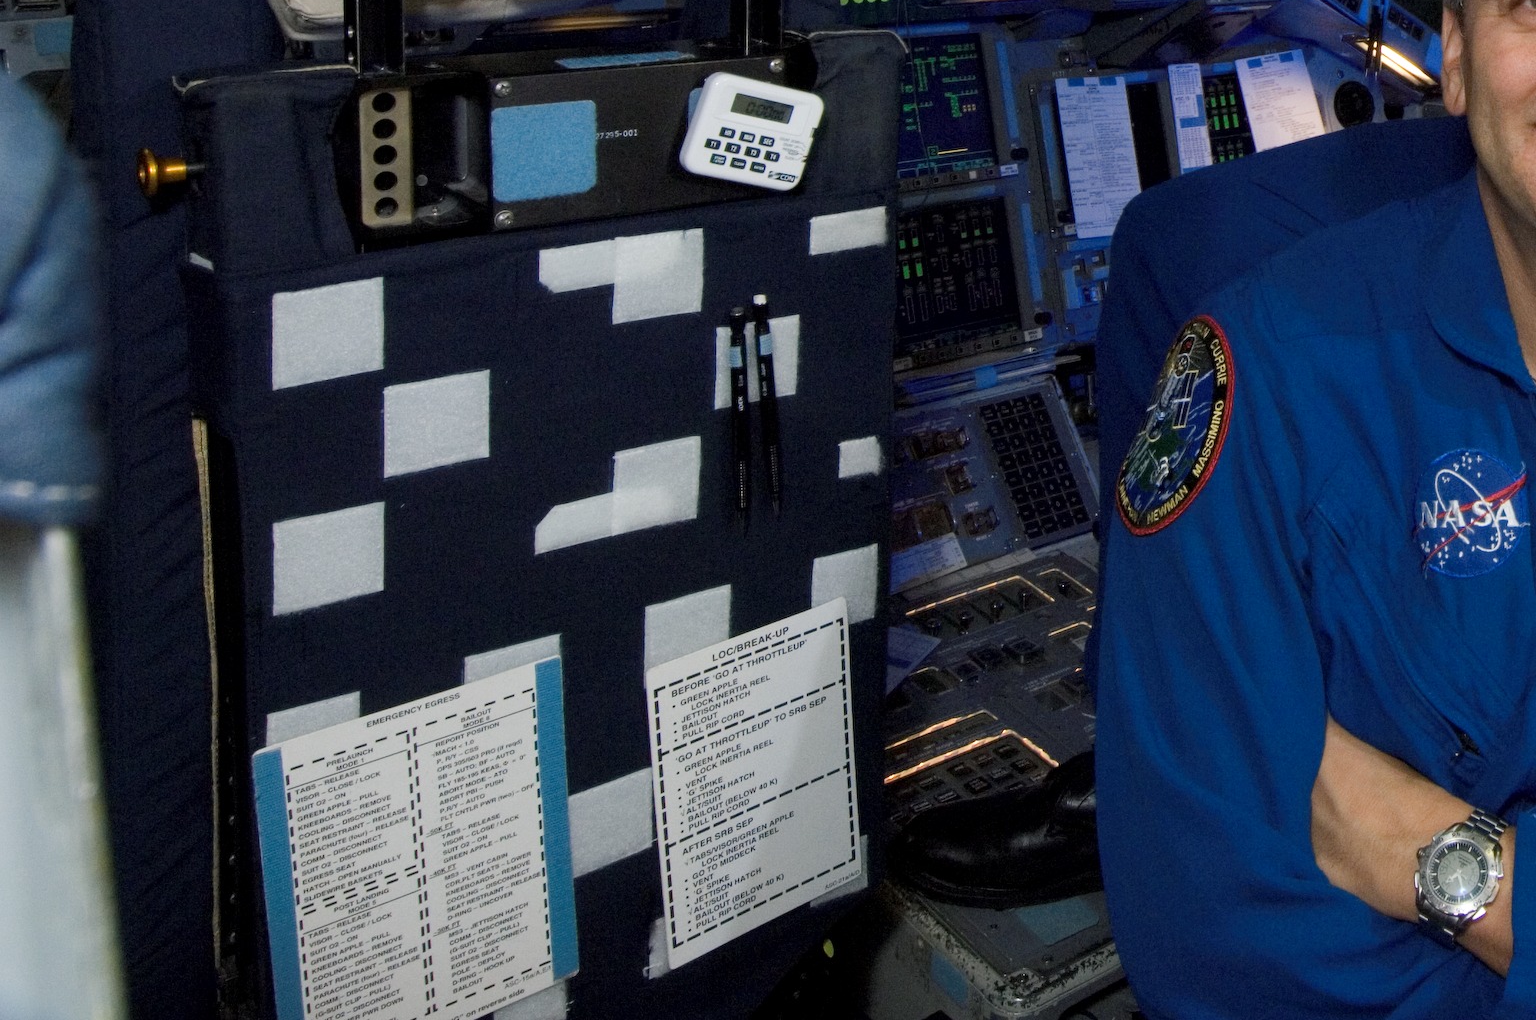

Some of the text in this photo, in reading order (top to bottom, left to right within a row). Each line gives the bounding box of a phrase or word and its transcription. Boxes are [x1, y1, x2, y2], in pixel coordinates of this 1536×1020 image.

[1210, 339, 1227, 386] CURRIE
[1192, 400, 1224, 477] MASSIMINO
[1146, 485, 1188, 525] NEWMAN
[1420, 500, 1520, 529] NASA
[712, 627, 788, 661] LOC/BREAK-UP
[671, 639, 807, 697] BEFORE 'GO AT THROTTLEUP'
[680, 678, 737, 705] GREEN APPLE
[681, 690, 750, 723] JETTISON HATCH
[691, 675, 770, 710] LOCK INERTIA REEL
[366, 692, 460, 727] EMERGENCY EGRESS
[460, 708, 491, 722] BAILOUT
[463, 718, 484, 729] MODE
[681, 711, 717, 731] BAILOUT
[682, 710, 744, 739] PULL RIP CORD
[435, 721, 499, 747] REPORT POSITION
[675, 696, 826, 762] 'GO AT THROTTLEUP' TO SRB SEP
[326, 748, 373, 767] PRELAUNCH
[336, 760, 358, 771] MODE
[684, 744, 741, 772] GREEN APPLE
[695, 740, 773, 776] LOCK INERTIA REEL
[685, 774, 706, 788] VENT
[686, 776, 722, 796] 'G' SPIKE
[686, 771, 754, 805] JETTISON HATCH
[686, 794, 721, 814] ALT/SUIT
[688, 801, 723, 822] BAILOUT
[725, 787, 756, 806] (BELOW
[688, 799, 749, 831] PULL RIP CORD
[682, 817, 753, 855] AFTER SRB SEP
[690, 811, 794, 862] TABS/VISOR/GREEN APPLE
[701, 827, 779, 866] LOCK INERTIA REEL
[692, 845, 755, 879] GO TO MIDDECK
[692, 873, 713, 887] VENT
[333, 888, 389, 912] POST LANDING
[348, 904, 371, 914] MODE
